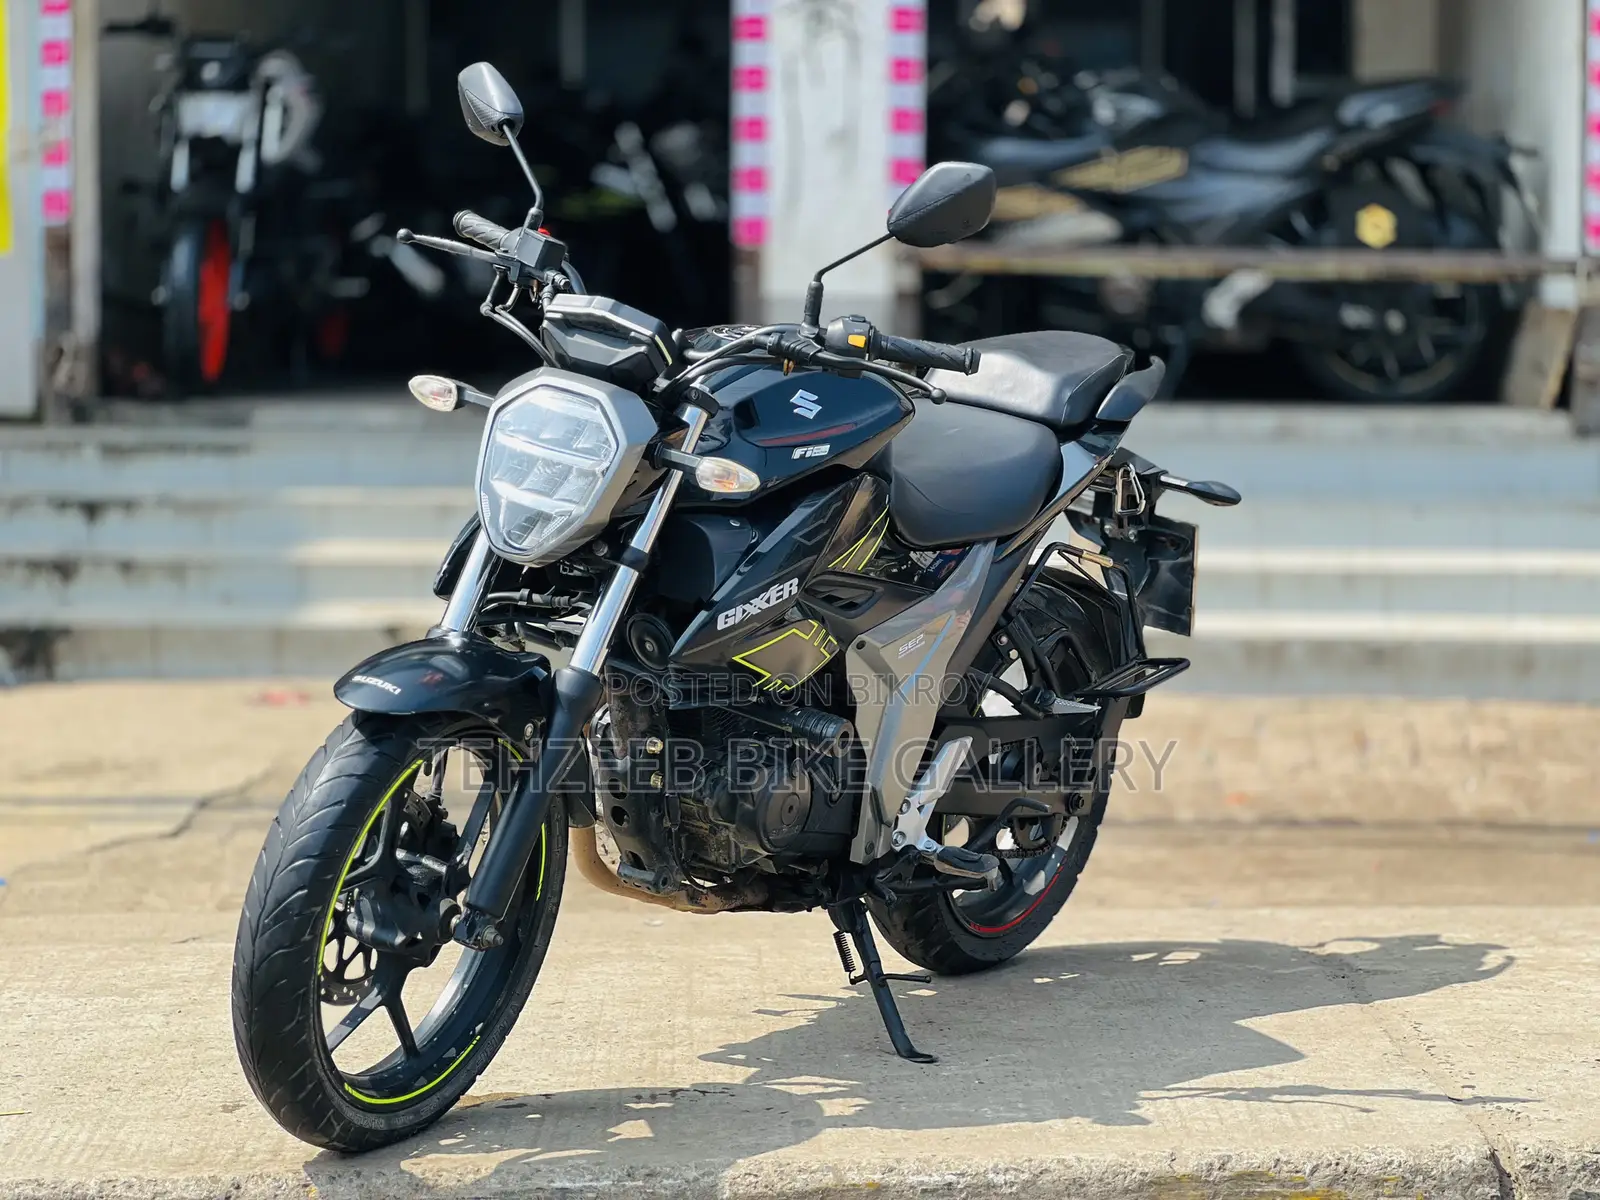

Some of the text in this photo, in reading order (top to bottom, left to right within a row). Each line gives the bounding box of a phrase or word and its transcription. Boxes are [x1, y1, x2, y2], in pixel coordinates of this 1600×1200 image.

[716, 577, 799, 631] GIXXER
[898, 633, 924, 655] SEP
[351, 675, 402, 695] SUZUKI
